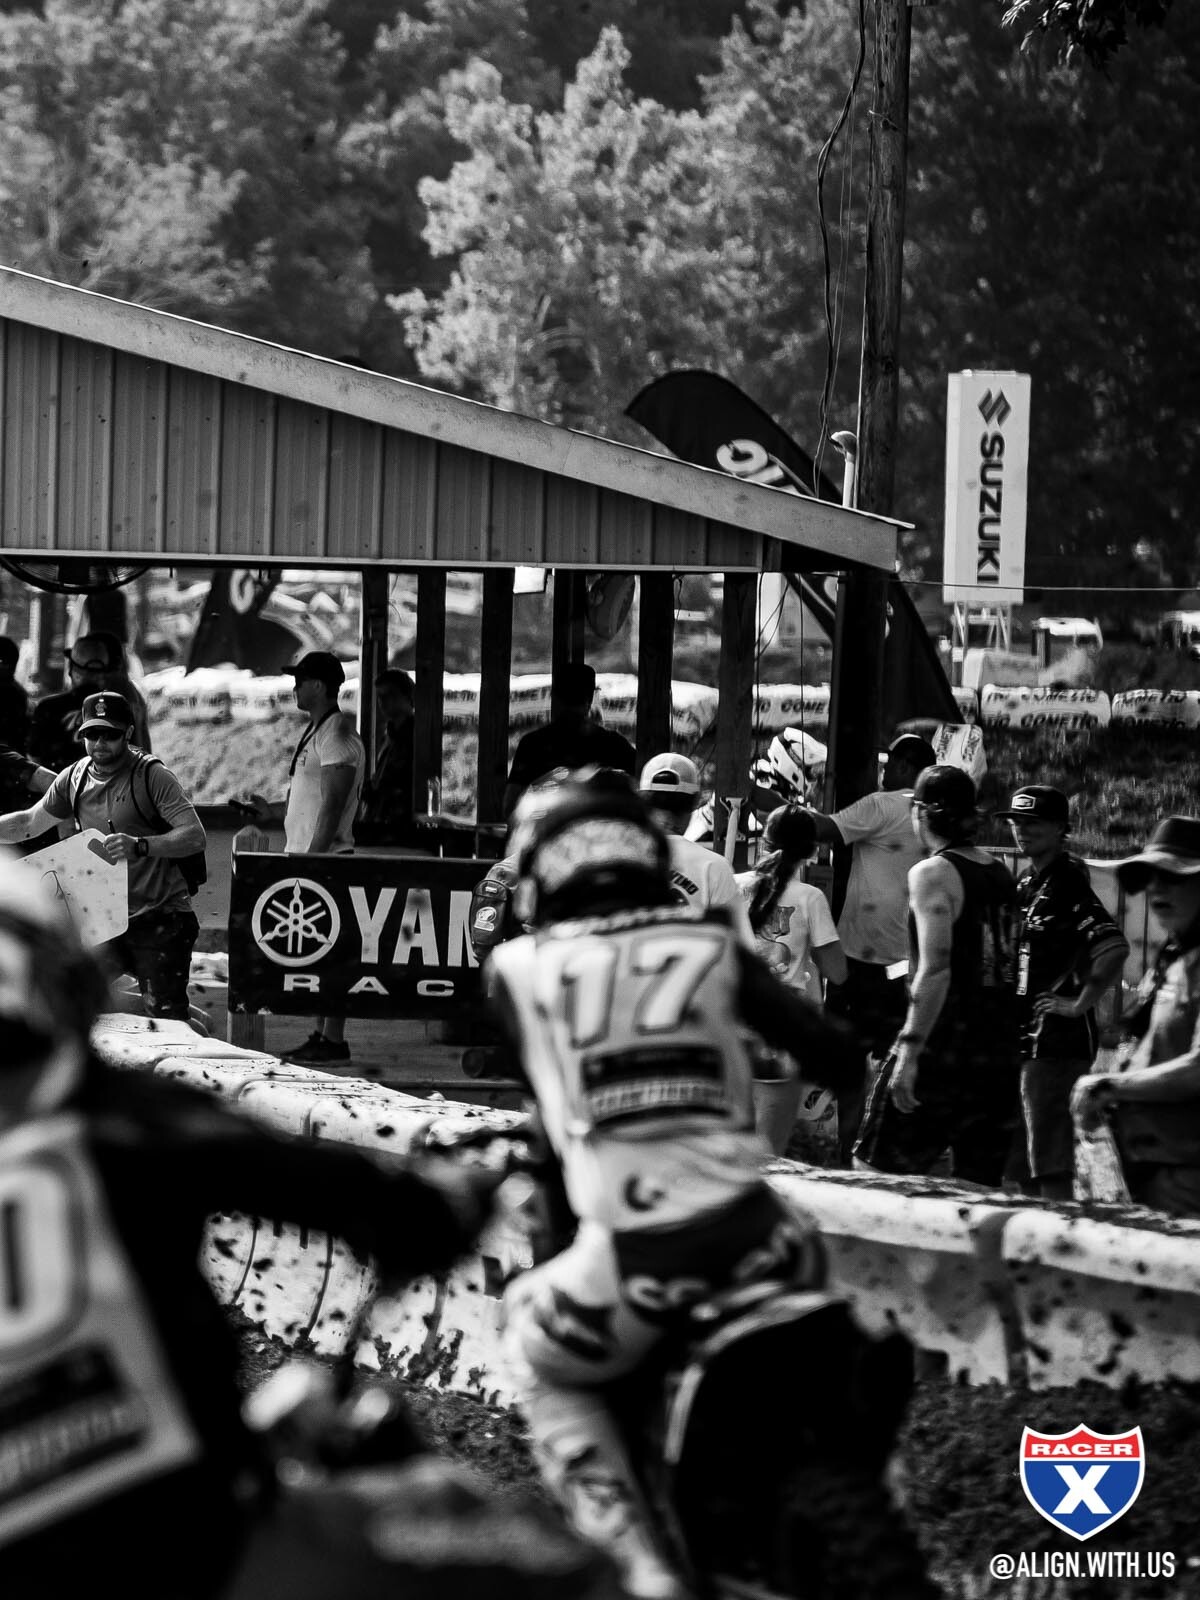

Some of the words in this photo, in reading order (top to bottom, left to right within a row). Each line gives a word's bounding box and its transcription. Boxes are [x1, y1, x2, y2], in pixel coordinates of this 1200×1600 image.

[977, 431, 1005, 584] SUZUKI
[283, 973, 454, 997] RAC
[560, 934, 725, 1049] 17
